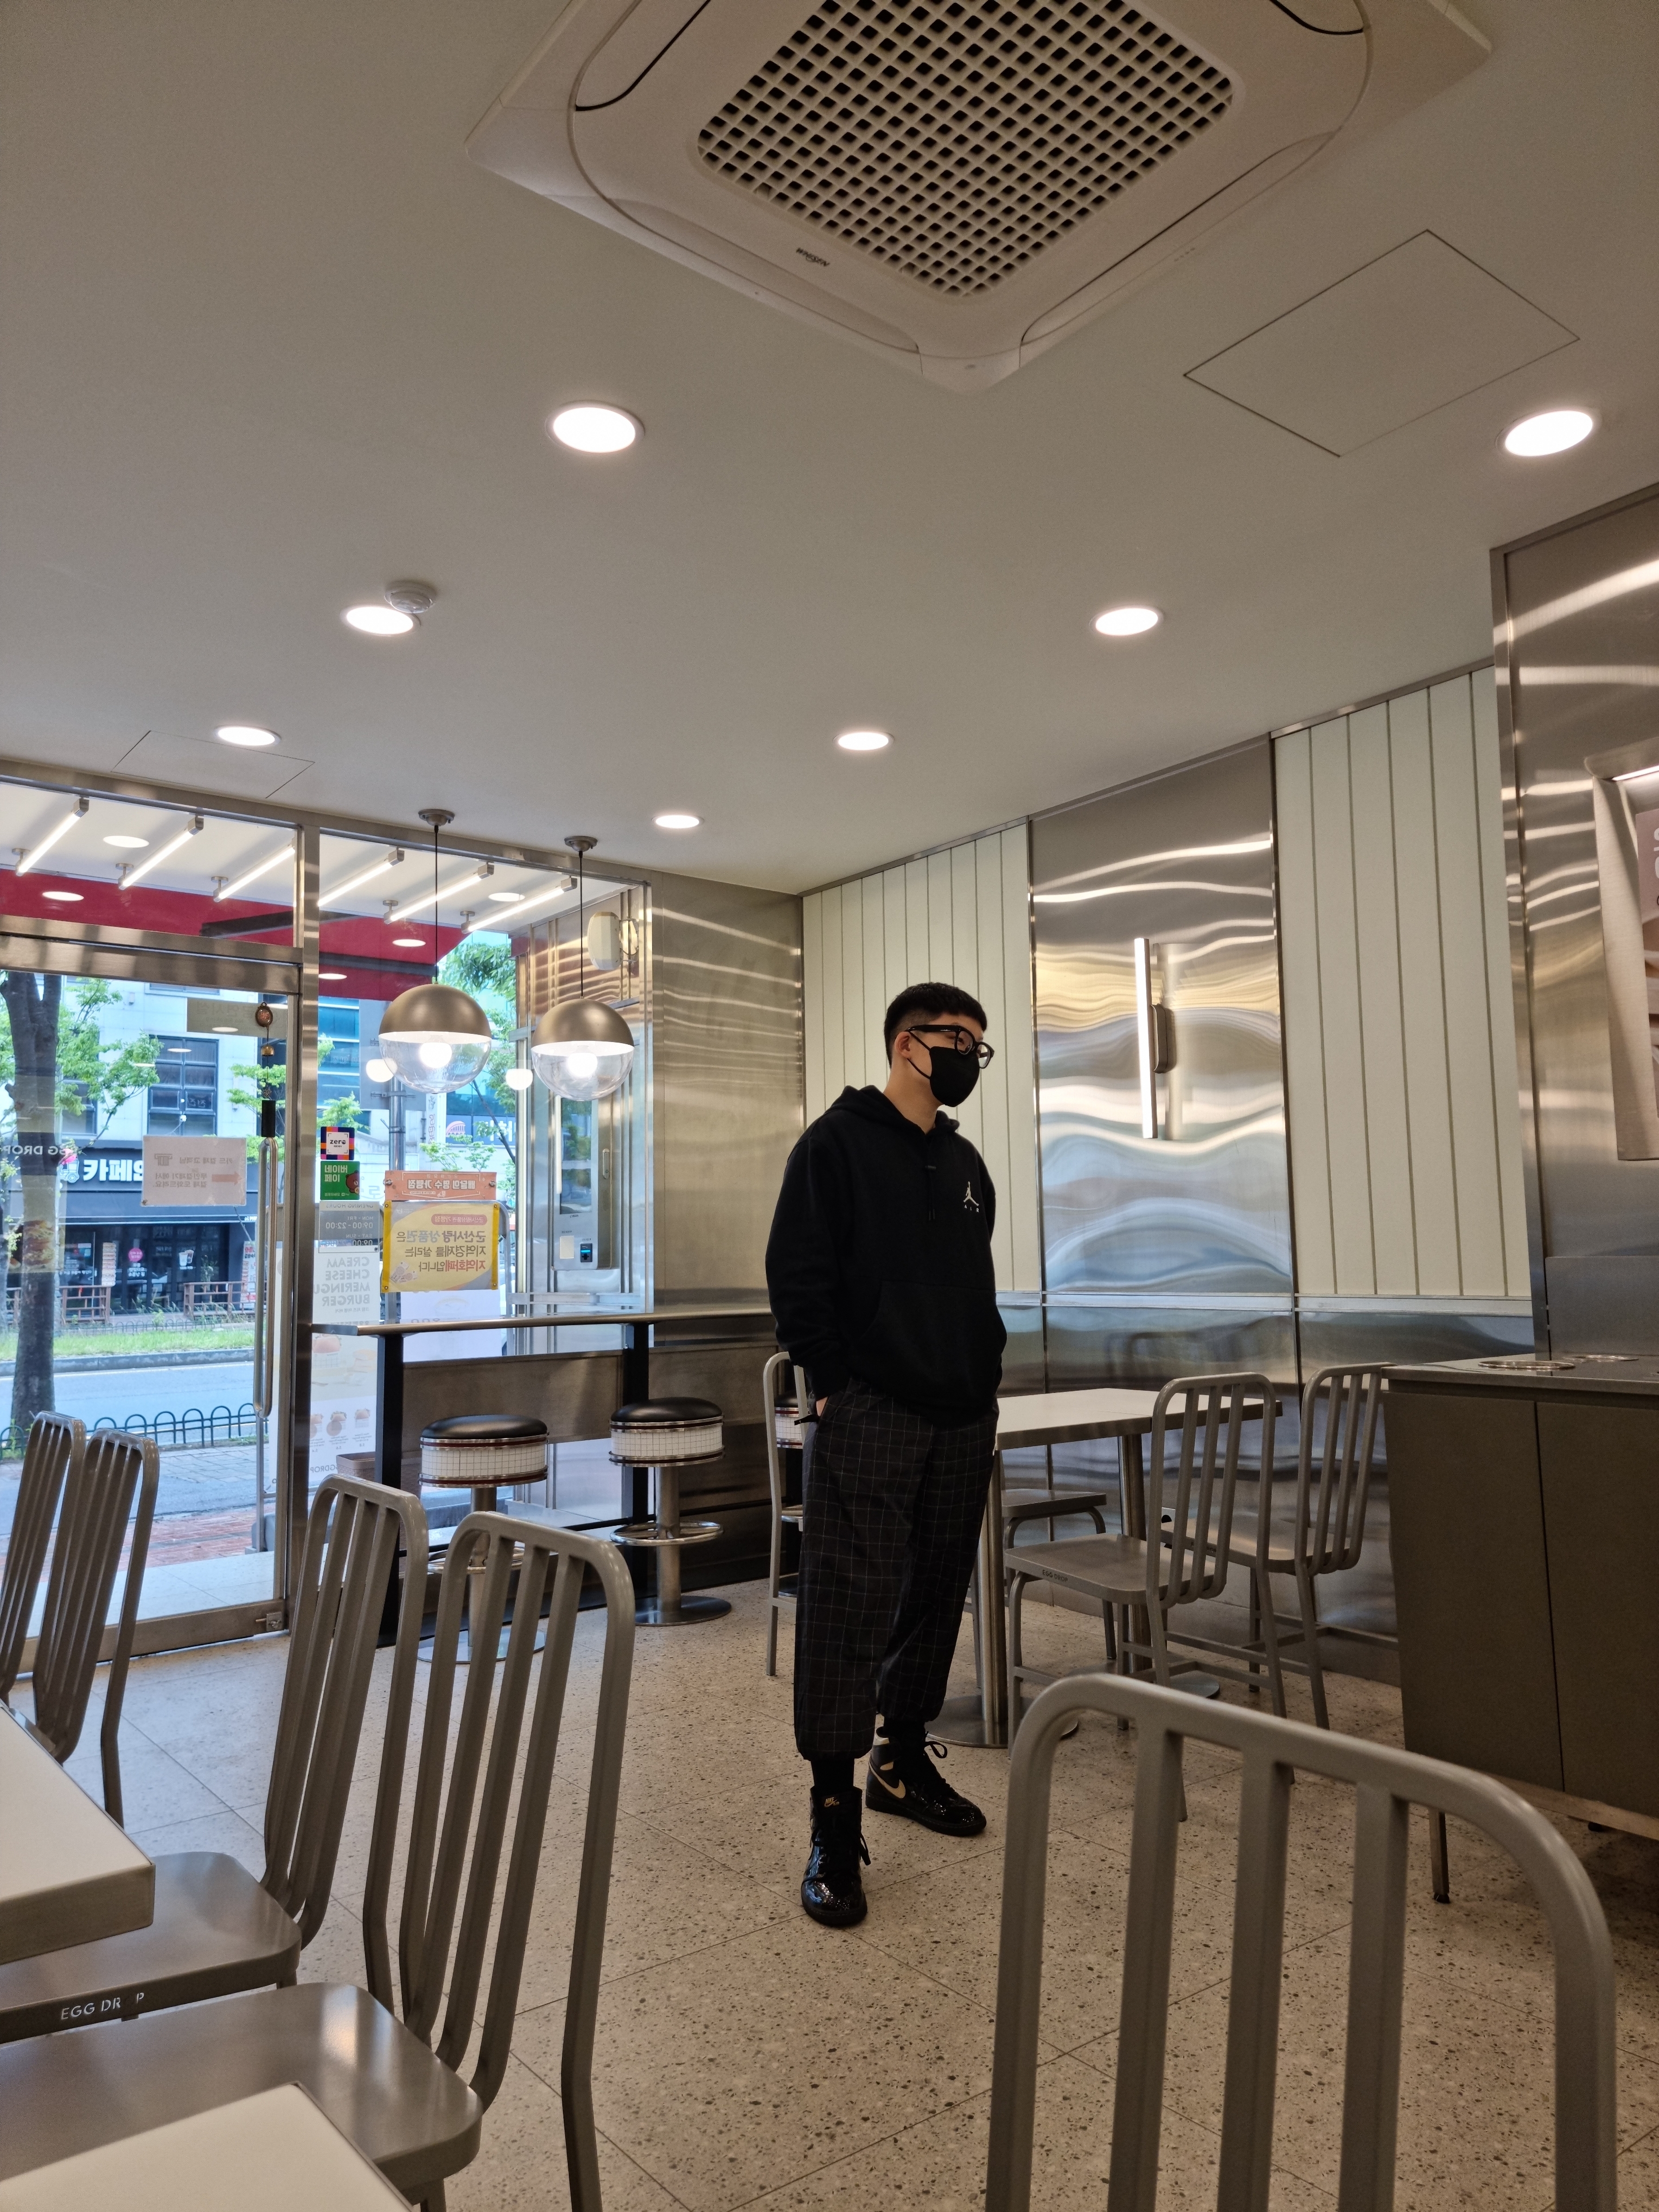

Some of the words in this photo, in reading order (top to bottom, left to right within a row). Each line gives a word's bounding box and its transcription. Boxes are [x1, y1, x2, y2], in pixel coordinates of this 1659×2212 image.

[796, 247, 830, 266] WHISEN
[324, 1165, 348, 1173] 네이버
[324, 1174, 340, 1182] 페이
[964, 1204, 980, 1213] AIR
[61, 2003, 95, 2019] EGG
[101, 1992, 144, 2011] DRP
